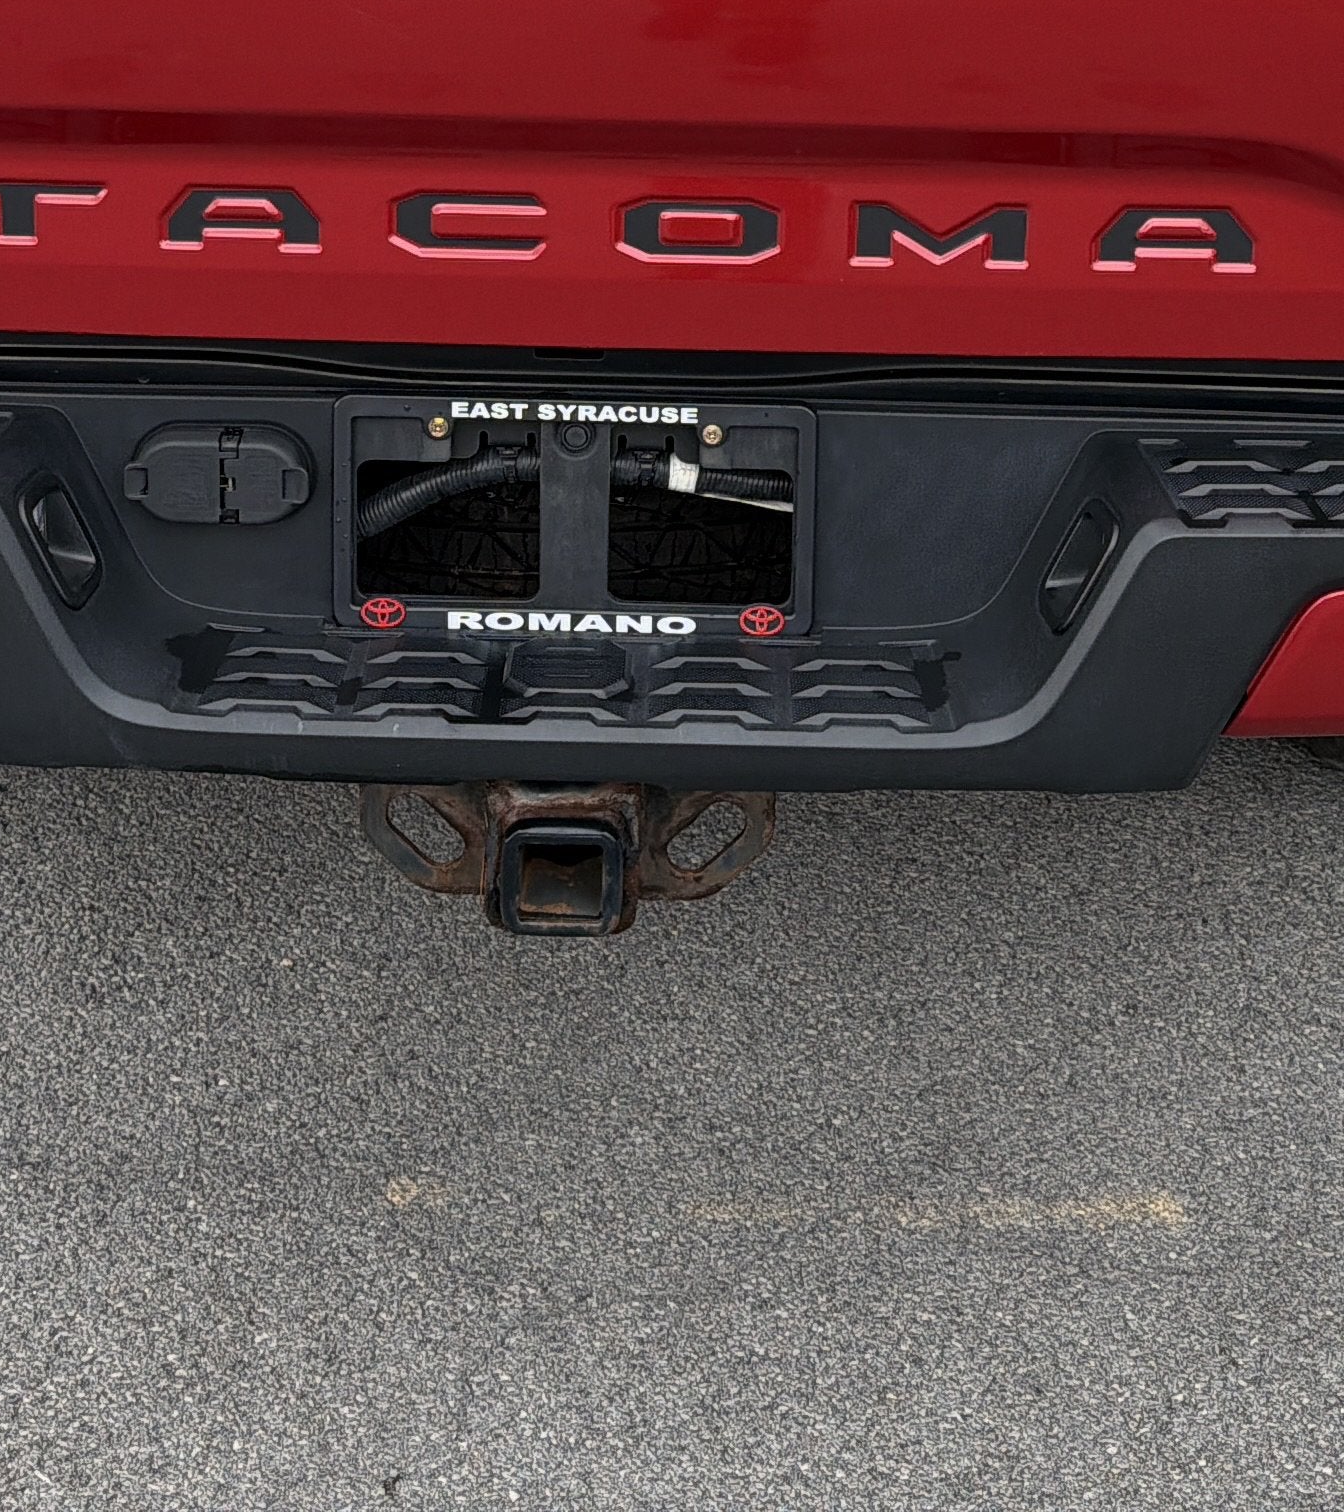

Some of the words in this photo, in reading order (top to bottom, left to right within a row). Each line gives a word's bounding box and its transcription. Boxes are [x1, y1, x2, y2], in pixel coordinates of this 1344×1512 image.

[451, 401, 528, 420] EAST
[537, 404, 699, 424] SYRACUSE
[447, 611, 697, 635] ROMANO
